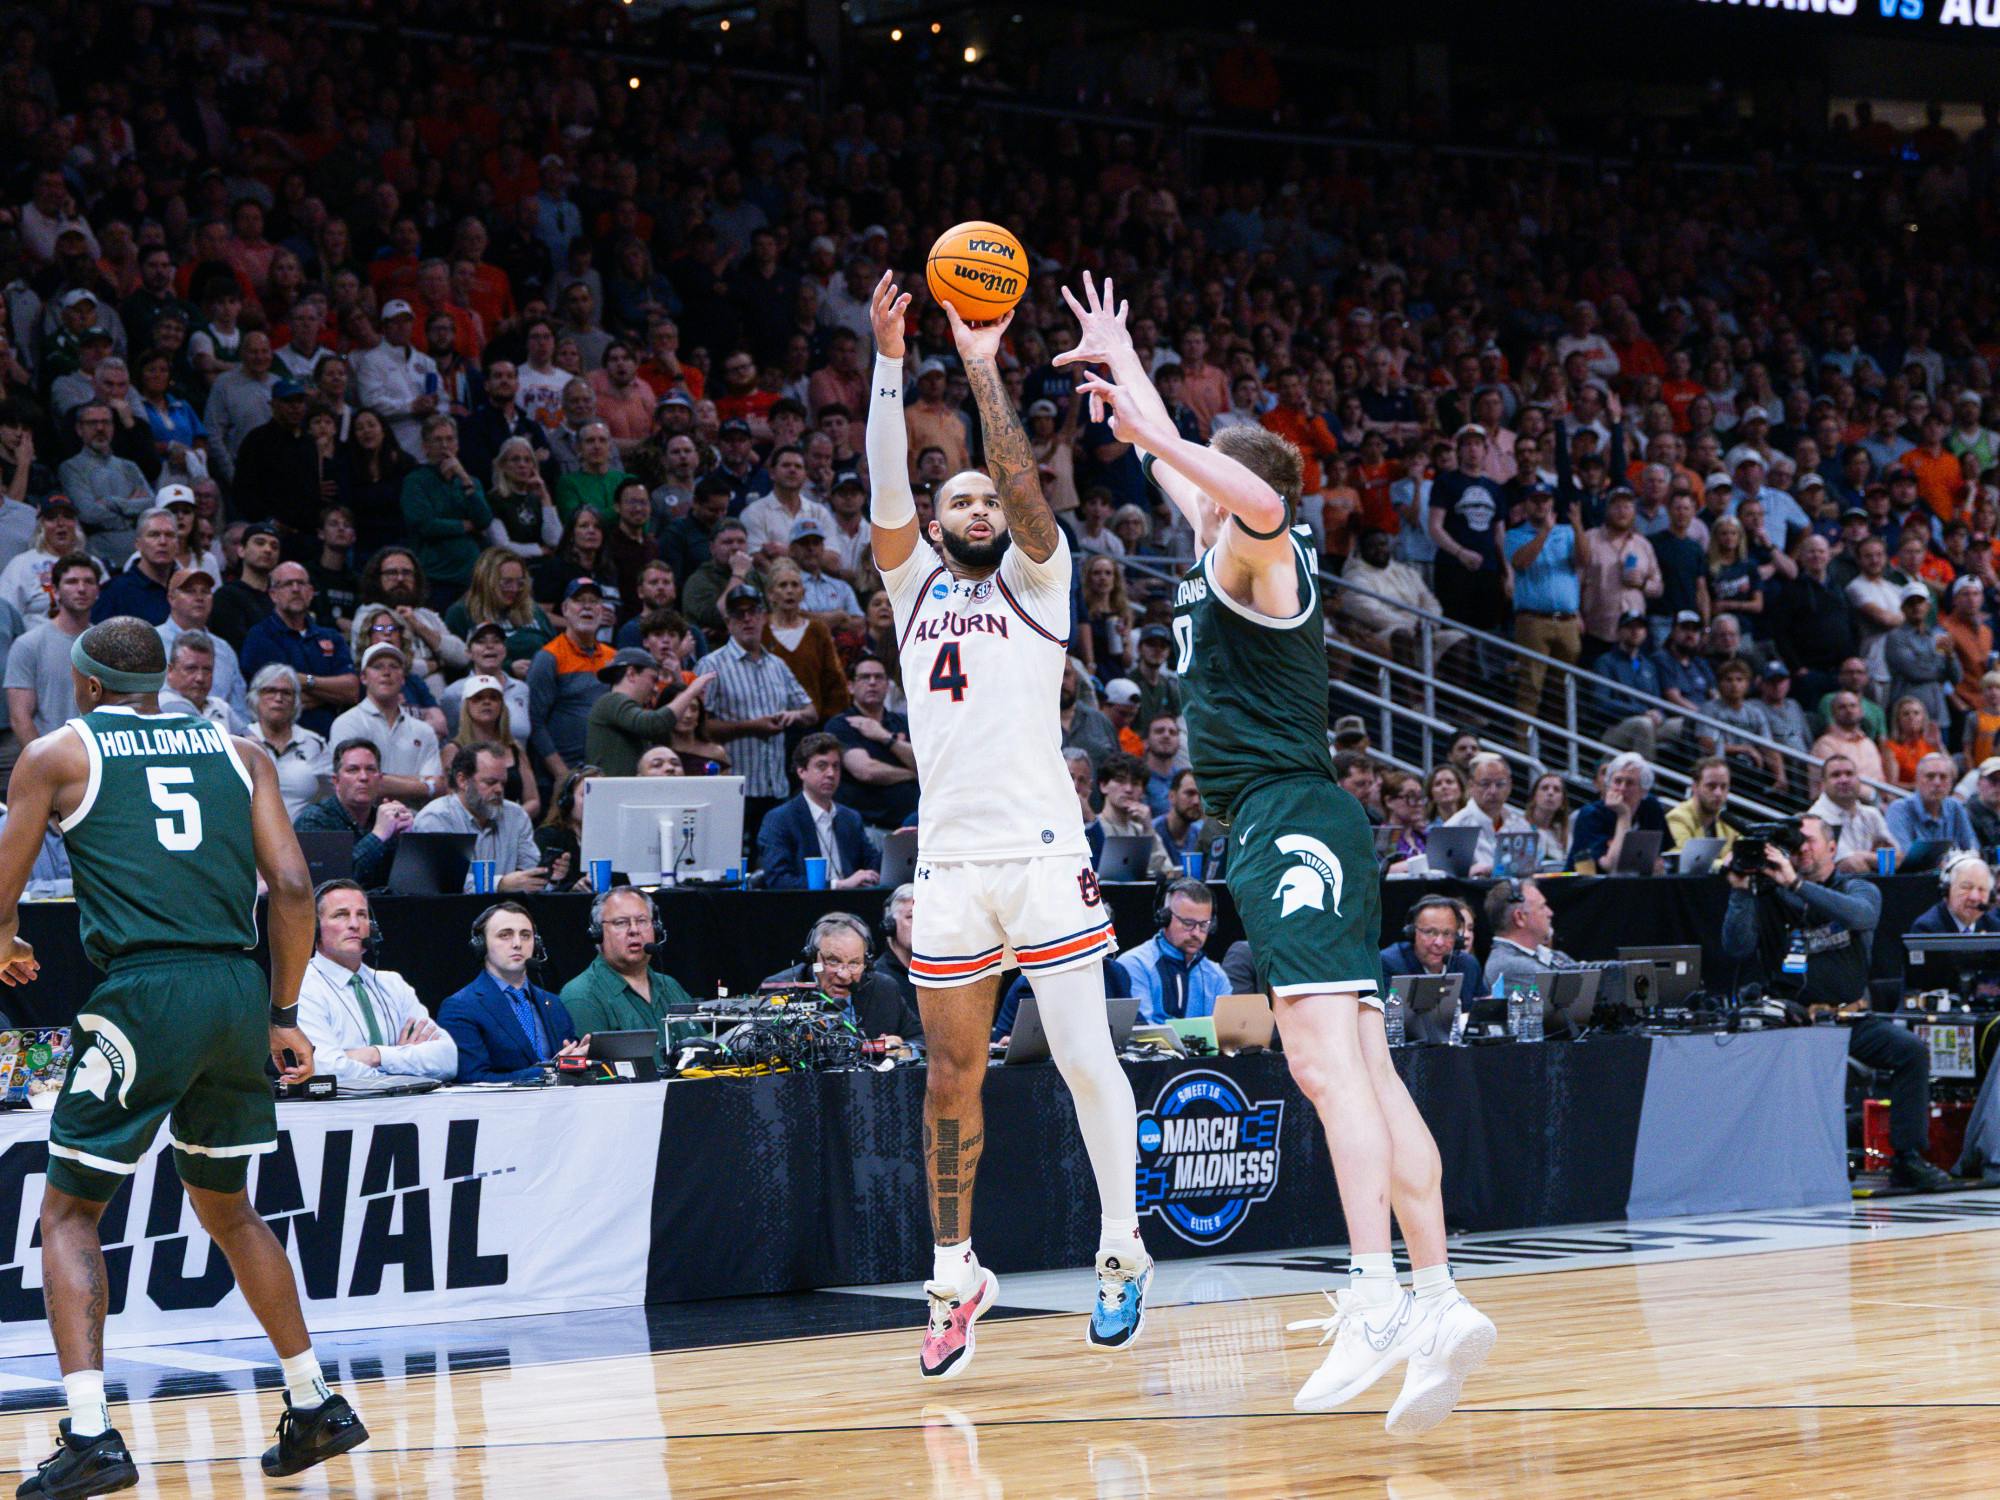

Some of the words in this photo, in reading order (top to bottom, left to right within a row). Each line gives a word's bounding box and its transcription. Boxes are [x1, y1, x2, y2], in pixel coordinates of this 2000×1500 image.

[968, 239, 1015, 260] NCAA
[955, 264, 1018, 295] Wilson
[929, 641, 969, 703] 4
[96, 728, 224, 757] HOLLOMAN
[146, 767, 203, 852] 5
[1177, 1084, 1207, 1103] SWEET
[1209, 1084, 1222, 1099] 16
[1162, 1116, 1239, 1154] MARCH
[1174, 1150, 1275, 1190] MADNESS
[1190, 1216, 1214, 1231] ELITE
